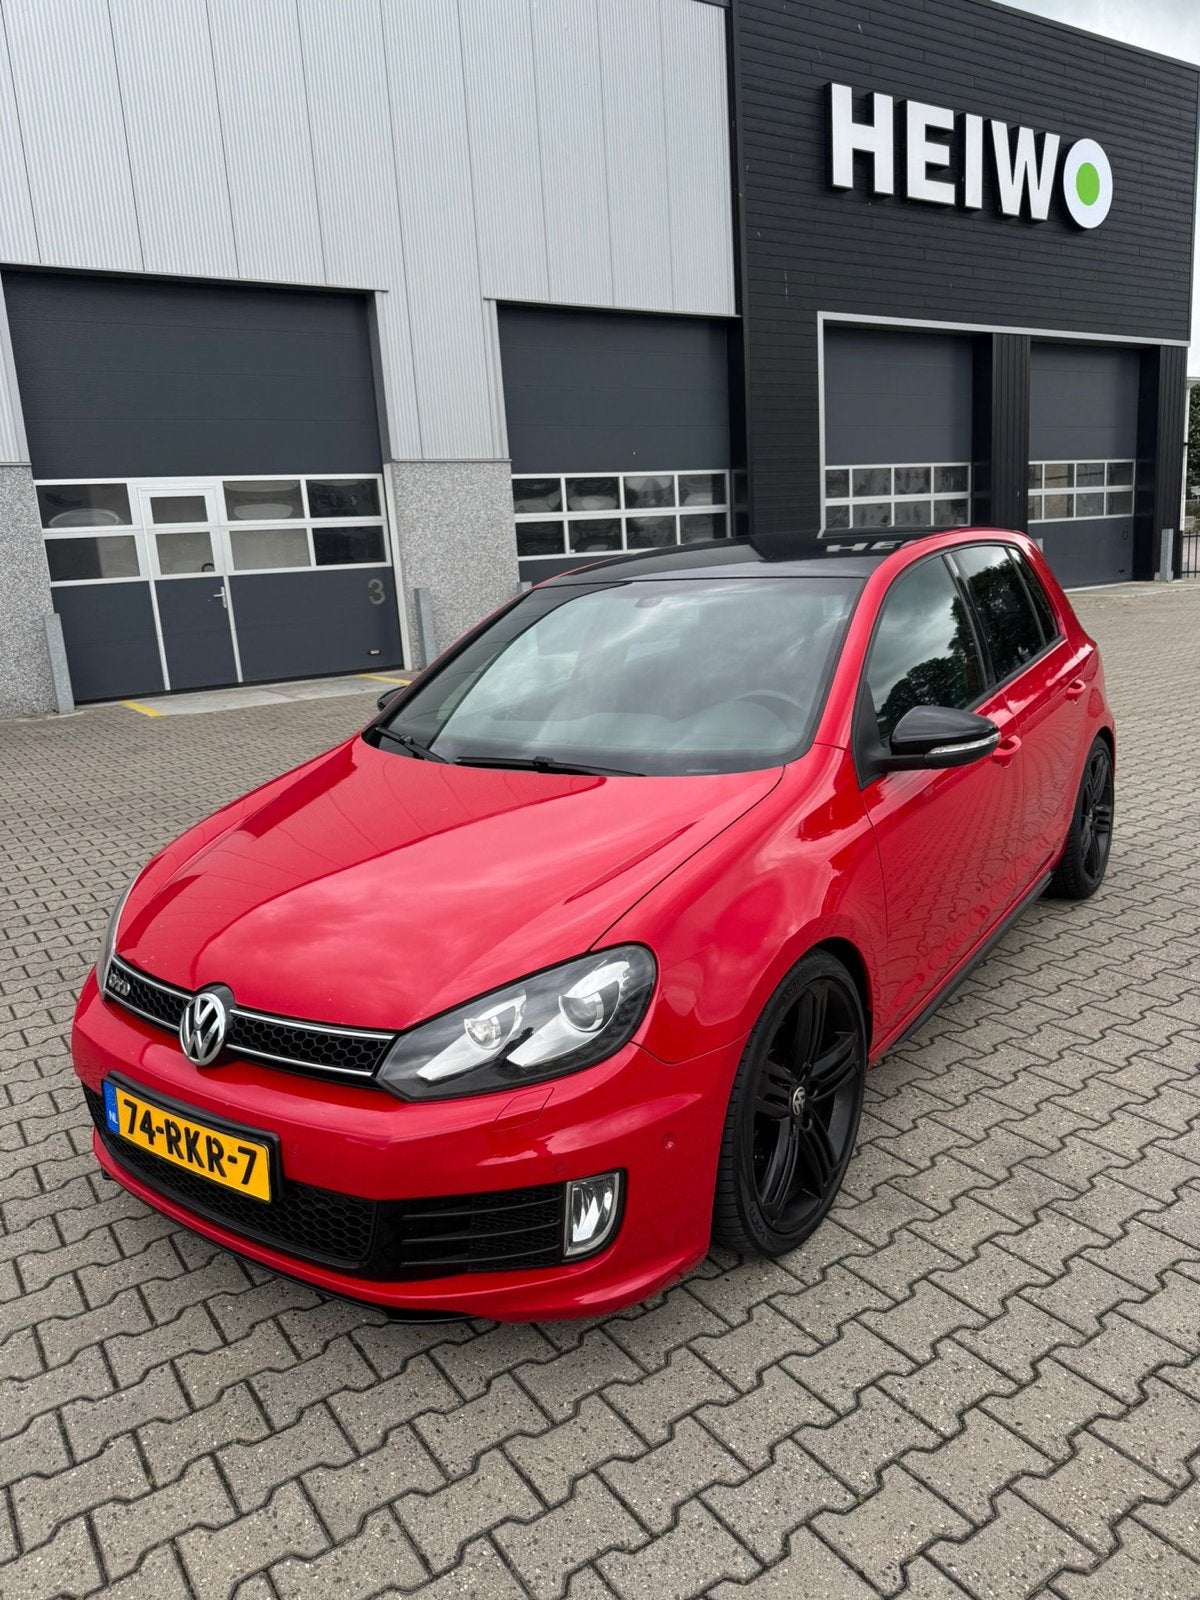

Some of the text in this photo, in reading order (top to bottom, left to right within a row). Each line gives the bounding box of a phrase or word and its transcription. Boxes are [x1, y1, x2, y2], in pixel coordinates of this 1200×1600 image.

[831, 82, 1113, 229] HEIWO
[368, 578, 386, 605] 3
[108, 1110, 119, 1125] NL
[123, 1099, 258, 1186] 74-RKR-7
